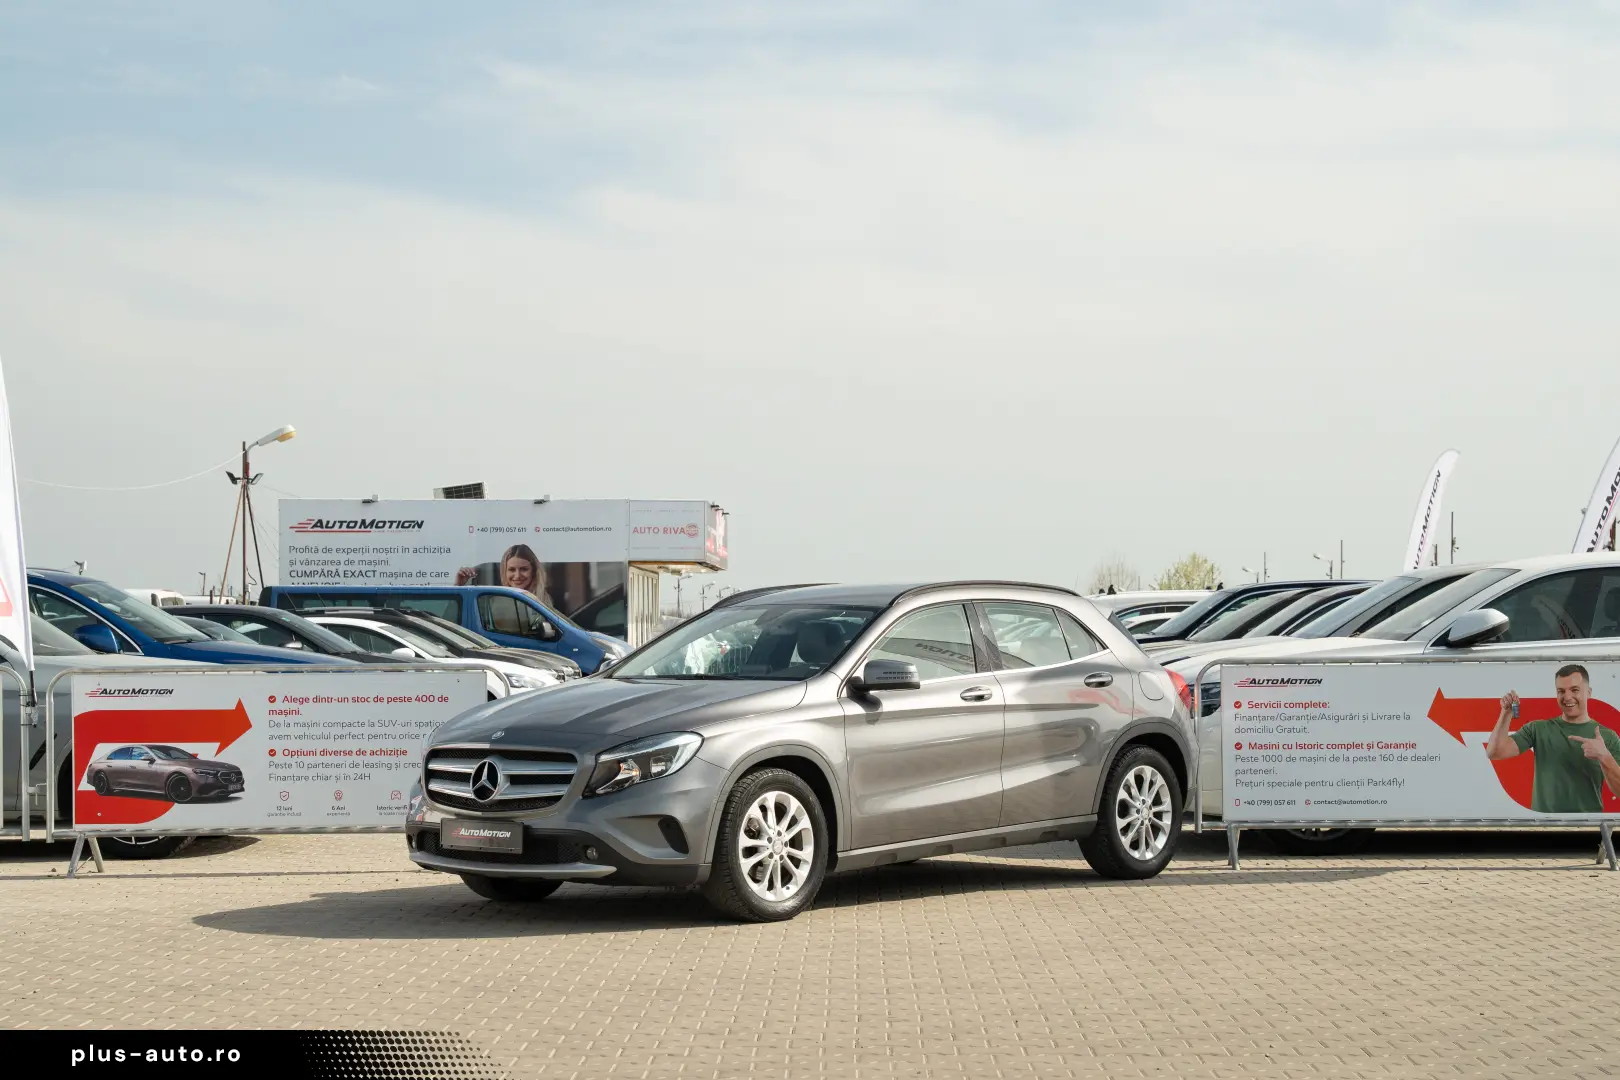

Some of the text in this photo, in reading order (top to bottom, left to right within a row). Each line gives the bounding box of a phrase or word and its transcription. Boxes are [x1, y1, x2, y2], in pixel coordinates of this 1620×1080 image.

[632, 526, 660, 535] AUTO
[663, 526, 686, 535] RIVA
[289, 545, 319, 554] Profită
[322, 545, 333, 554] de
[335, 545, 370, 556] experții
[372, 545, 399, 556] noștri
[412, 545, 451, 556] achiziția
[288, 558, 297, 568] și
[343, 558, 356, 566] de
[358, 558, 391, 568] mașini.
[289, 568, 341, 578] CUMPĂRĂ
[343, 570, 377, 578] EXACT
[379, 571, 413, 579] mașina
[415, 570, 427, 578] de
[282, 694, 449, 706] Alege dintr-un stoc de peste 400 de
[1247, 700, 1330, 711] Servicii complete:
[268, 708, 302, 717] mașini.
[1362, 713, 1369, 723] și
[1371, 712, 1400, 721] Livrare
[1403, 712, 1411, 721] la
[268, 720, 281, 728] De
[283, 719, 291, 728] la
[293, 719, 321, 730] mașini
[322, 719, 366, 730] compacte
[368, 719, 375, 728] la
[377, 719, 412, 728] SUV-uri
[1234, 725, 1309, 734] domiciliu Gratuit.
[268, 733, 292, 741] avem
[293, 732, 331, 741] vehiculul
[333, 732, 365, 742] perfect
[367, 732, 397, 742] pentru
[398, 732, 420, 740] orice
[1295, 742, 1324, 750] Istoric
[1326, 742, 1364, 752] complet
[1366, 741, 1374, 752] și
[1376, 741, 1417, 751] Garanție
[282, 748, 408, 758] Opțiuni diverse de achiziție
[1235, 753, 1441, 764] Peste 1000 de mașini de la peste 160 de dealeri
[268, 761, 293, 769] Peste
[295, 761, 305, 769] 10
[306, 761, 347, 771] parteneri
[349, 761, 360, 769] de
[362, 761, 392, 771] leasing
[394, 761, 401, 771] și
[268, 772, 371, 782] Finanțare chiar și în 24H
[1234, 767, 1278, 777] parteneri.
[1235, 778, 1405, 789] Prețuri speciale pentru clienții Park4fly!
